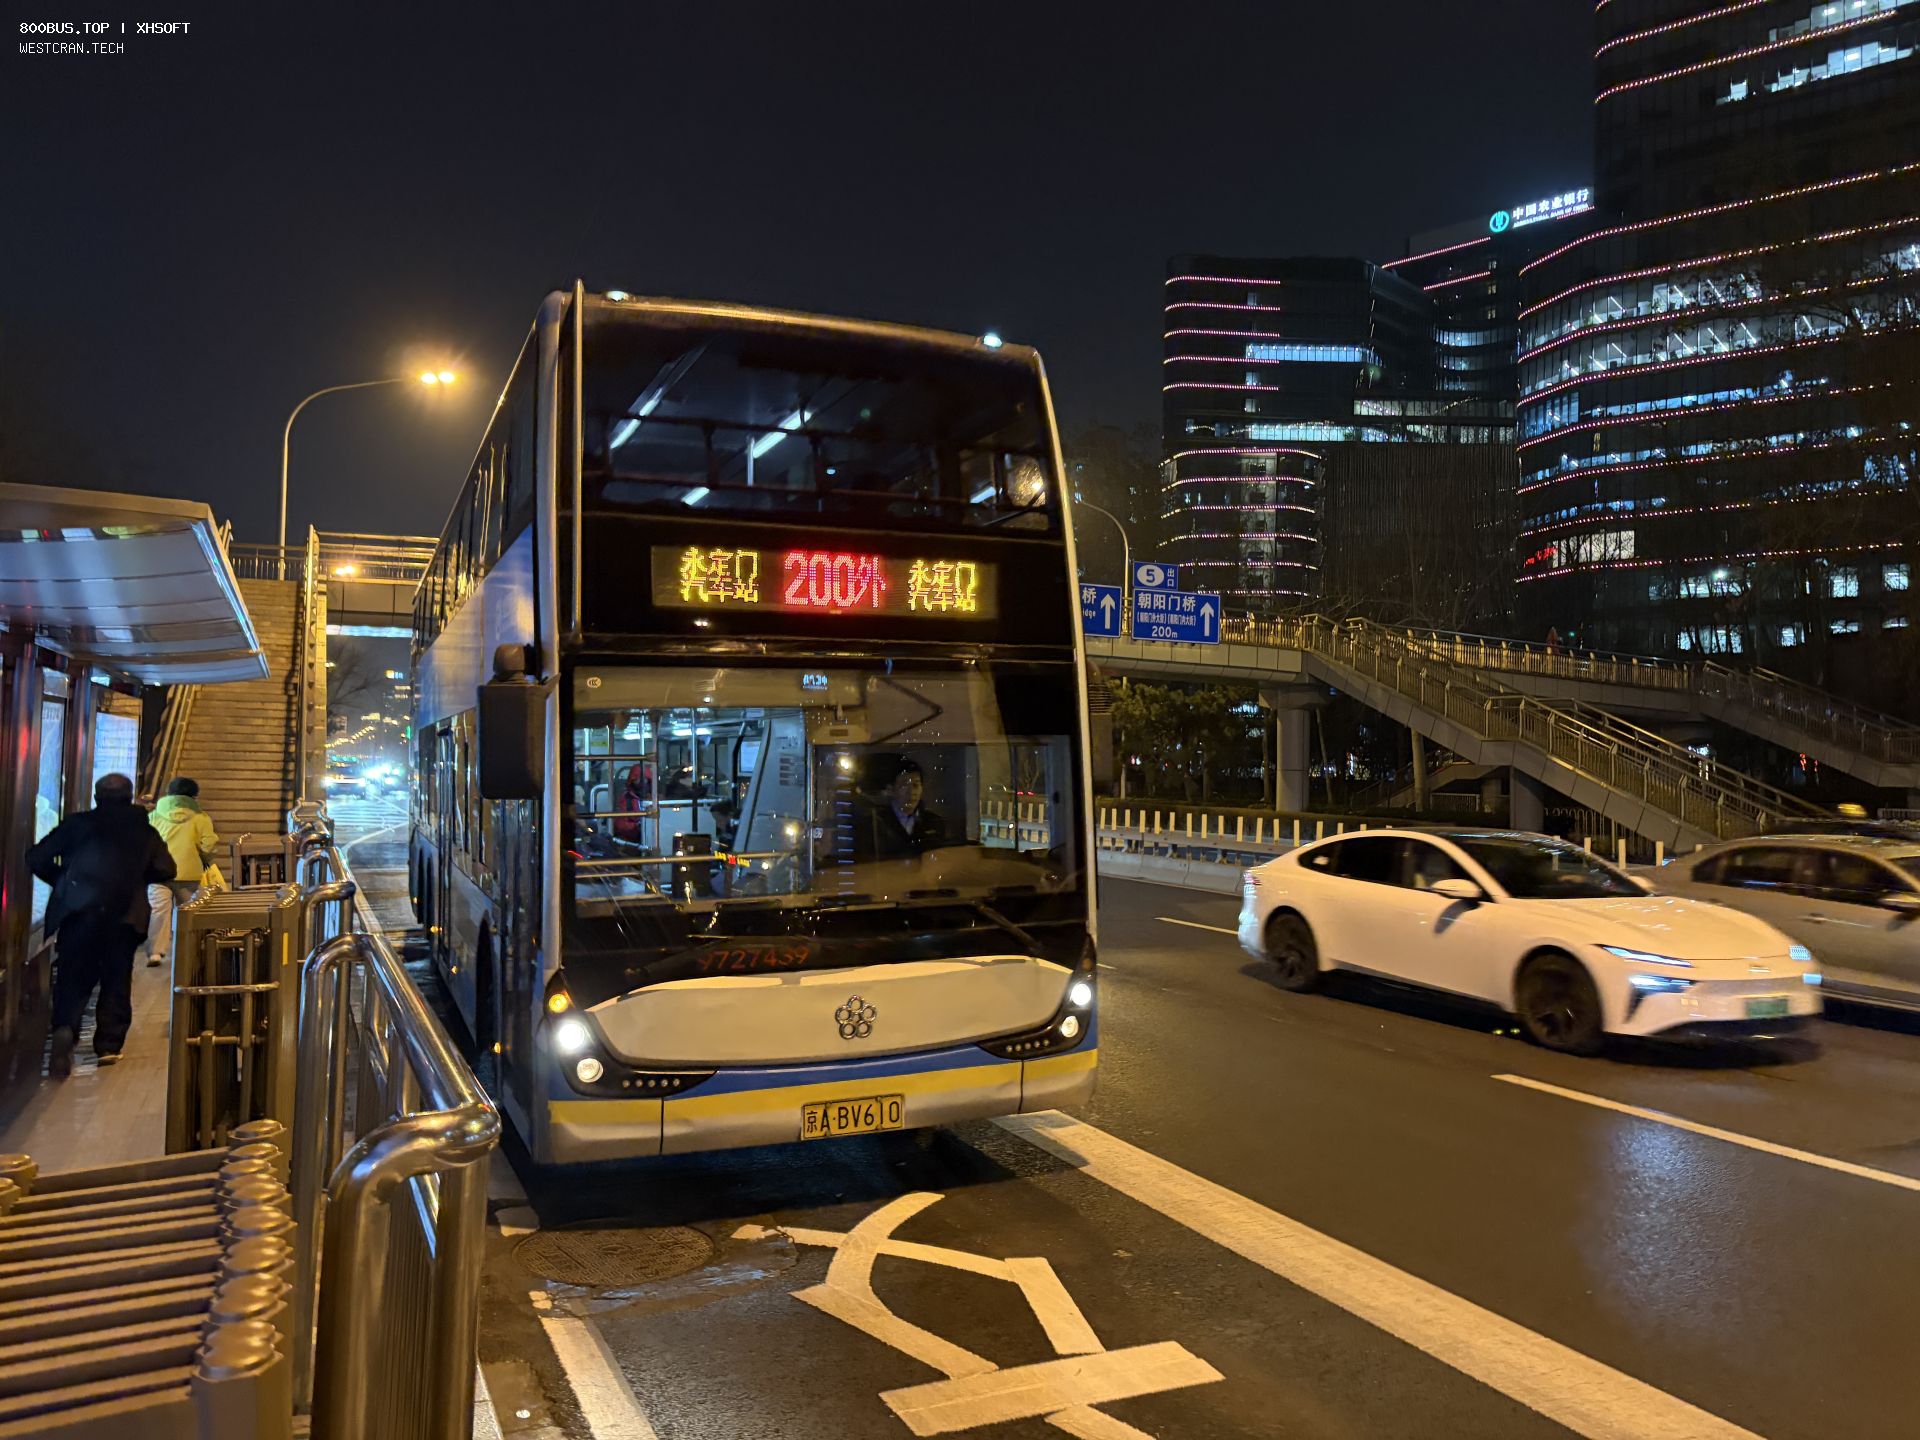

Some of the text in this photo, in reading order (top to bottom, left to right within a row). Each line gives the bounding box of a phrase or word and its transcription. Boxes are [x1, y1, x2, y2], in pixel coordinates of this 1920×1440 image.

[1512, 189, 1589, 220] 中国农业银行
[680, 547, 758, 578] 永定门
[908, 560, 976, 590] 永定门
[680, 575, 759, 602] 汽车站
[784, 552, 886, 608] 200外
[1146, 569, 1155, 583] 5
[1167, 568, 1175, 587] 出口
[908, 587, 976, 612] 汽车站
[1137, 592, 1196, 612] 朝阳门桥
[1152, 626, 1178, 638] 200m
